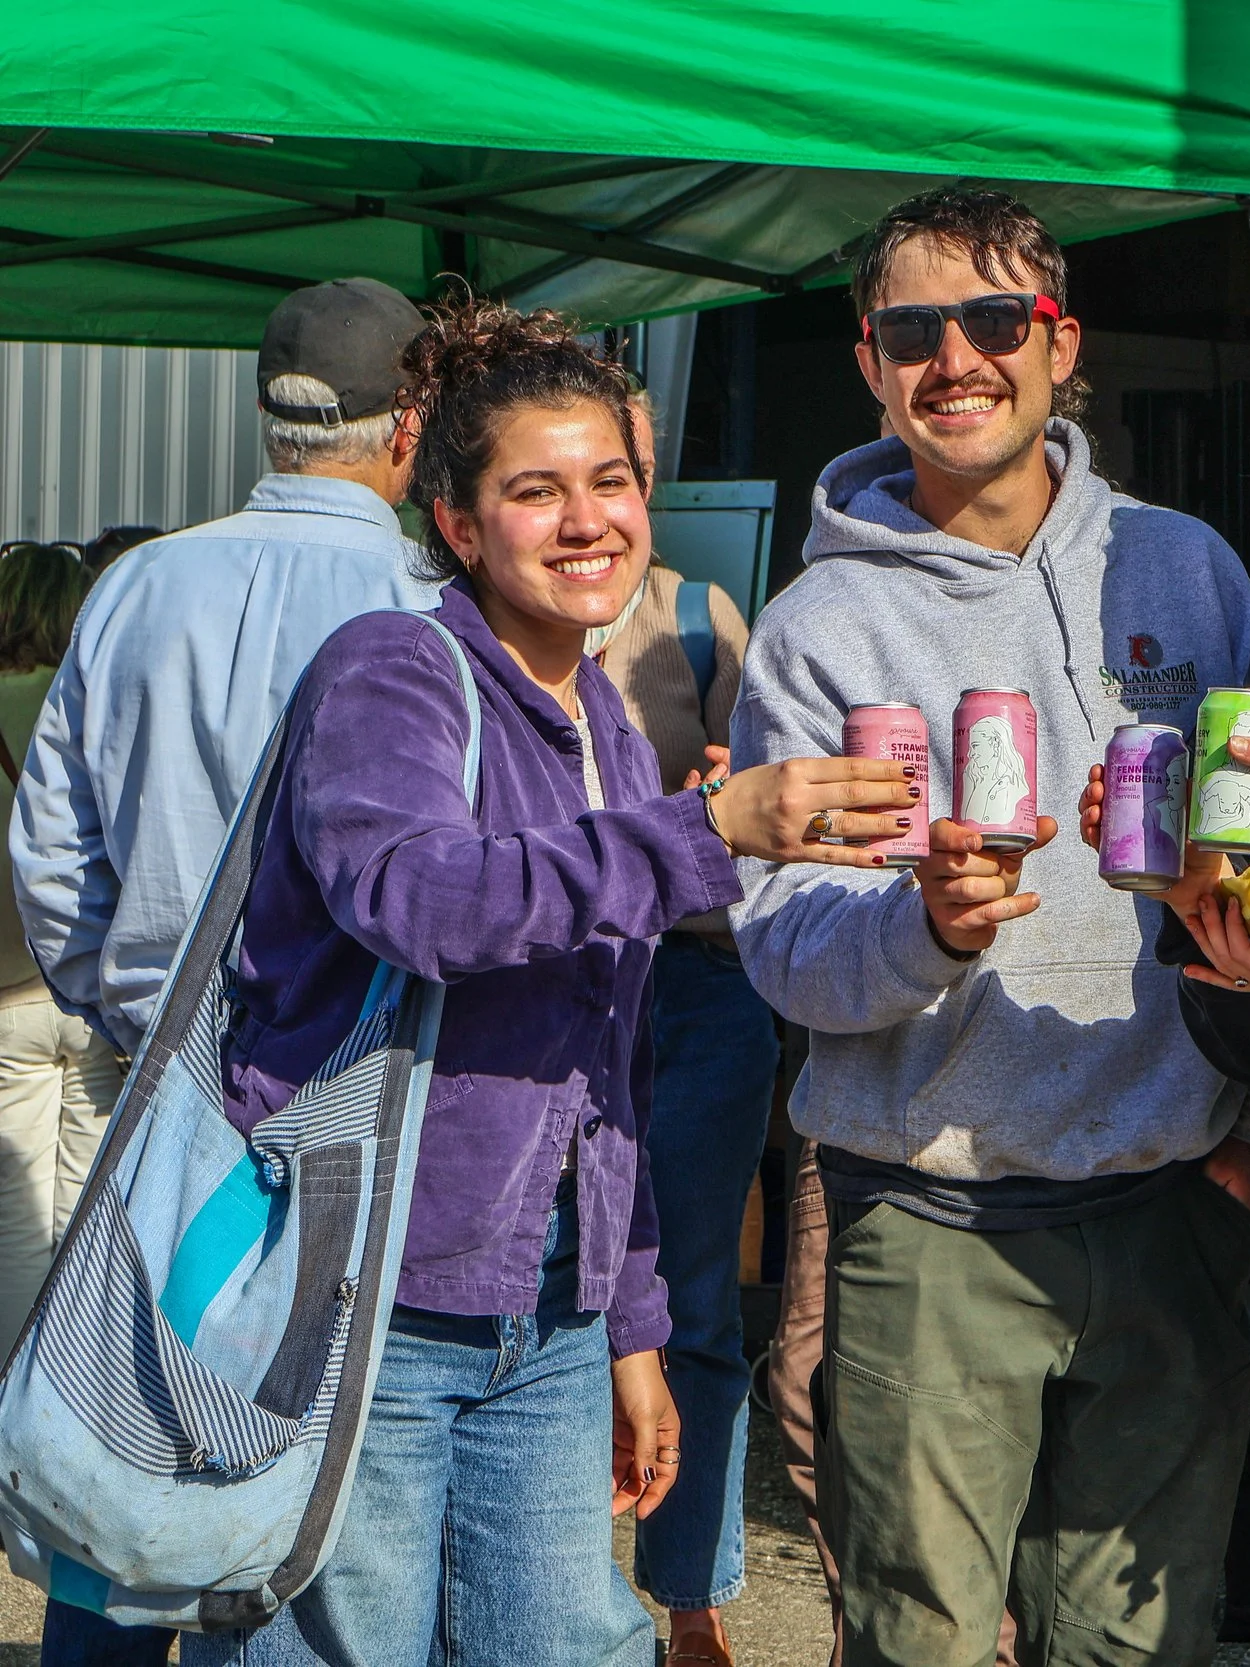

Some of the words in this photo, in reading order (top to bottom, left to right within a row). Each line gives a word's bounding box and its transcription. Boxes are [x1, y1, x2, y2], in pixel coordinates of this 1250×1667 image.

[1098, 660, 1198, 687] SALAMANDER
[1104, 683, 1198, 697] CONSTRUCTION
[891, 753, 914, 761] THAI
[1117, 765, 1155, 775] FENNEL
[1116, 774, 1163, 785] VERBENA
